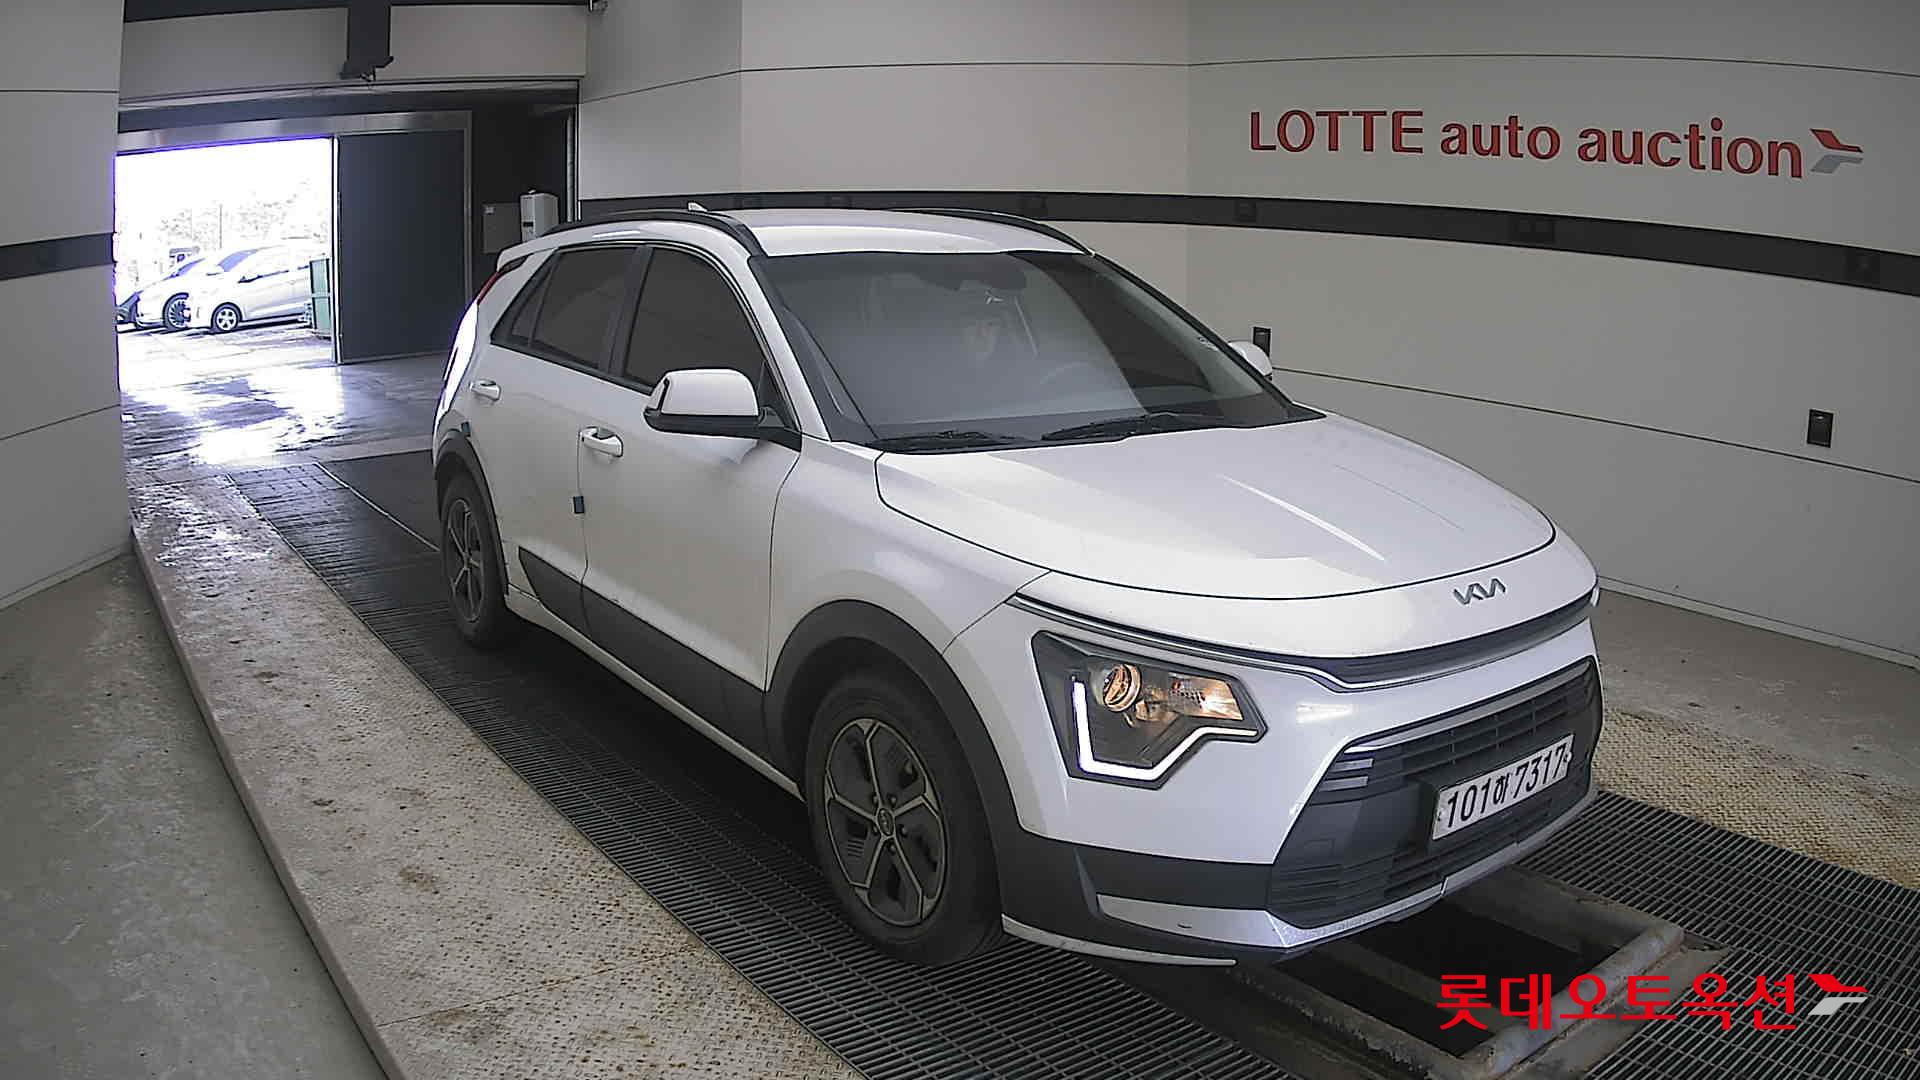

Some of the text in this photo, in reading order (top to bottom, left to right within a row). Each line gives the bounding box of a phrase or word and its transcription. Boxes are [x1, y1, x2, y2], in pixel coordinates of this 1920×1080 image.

[1249, 109, 1803, 179] LOTTE auto auction
[1513, 742, 1568, 799] 7317
